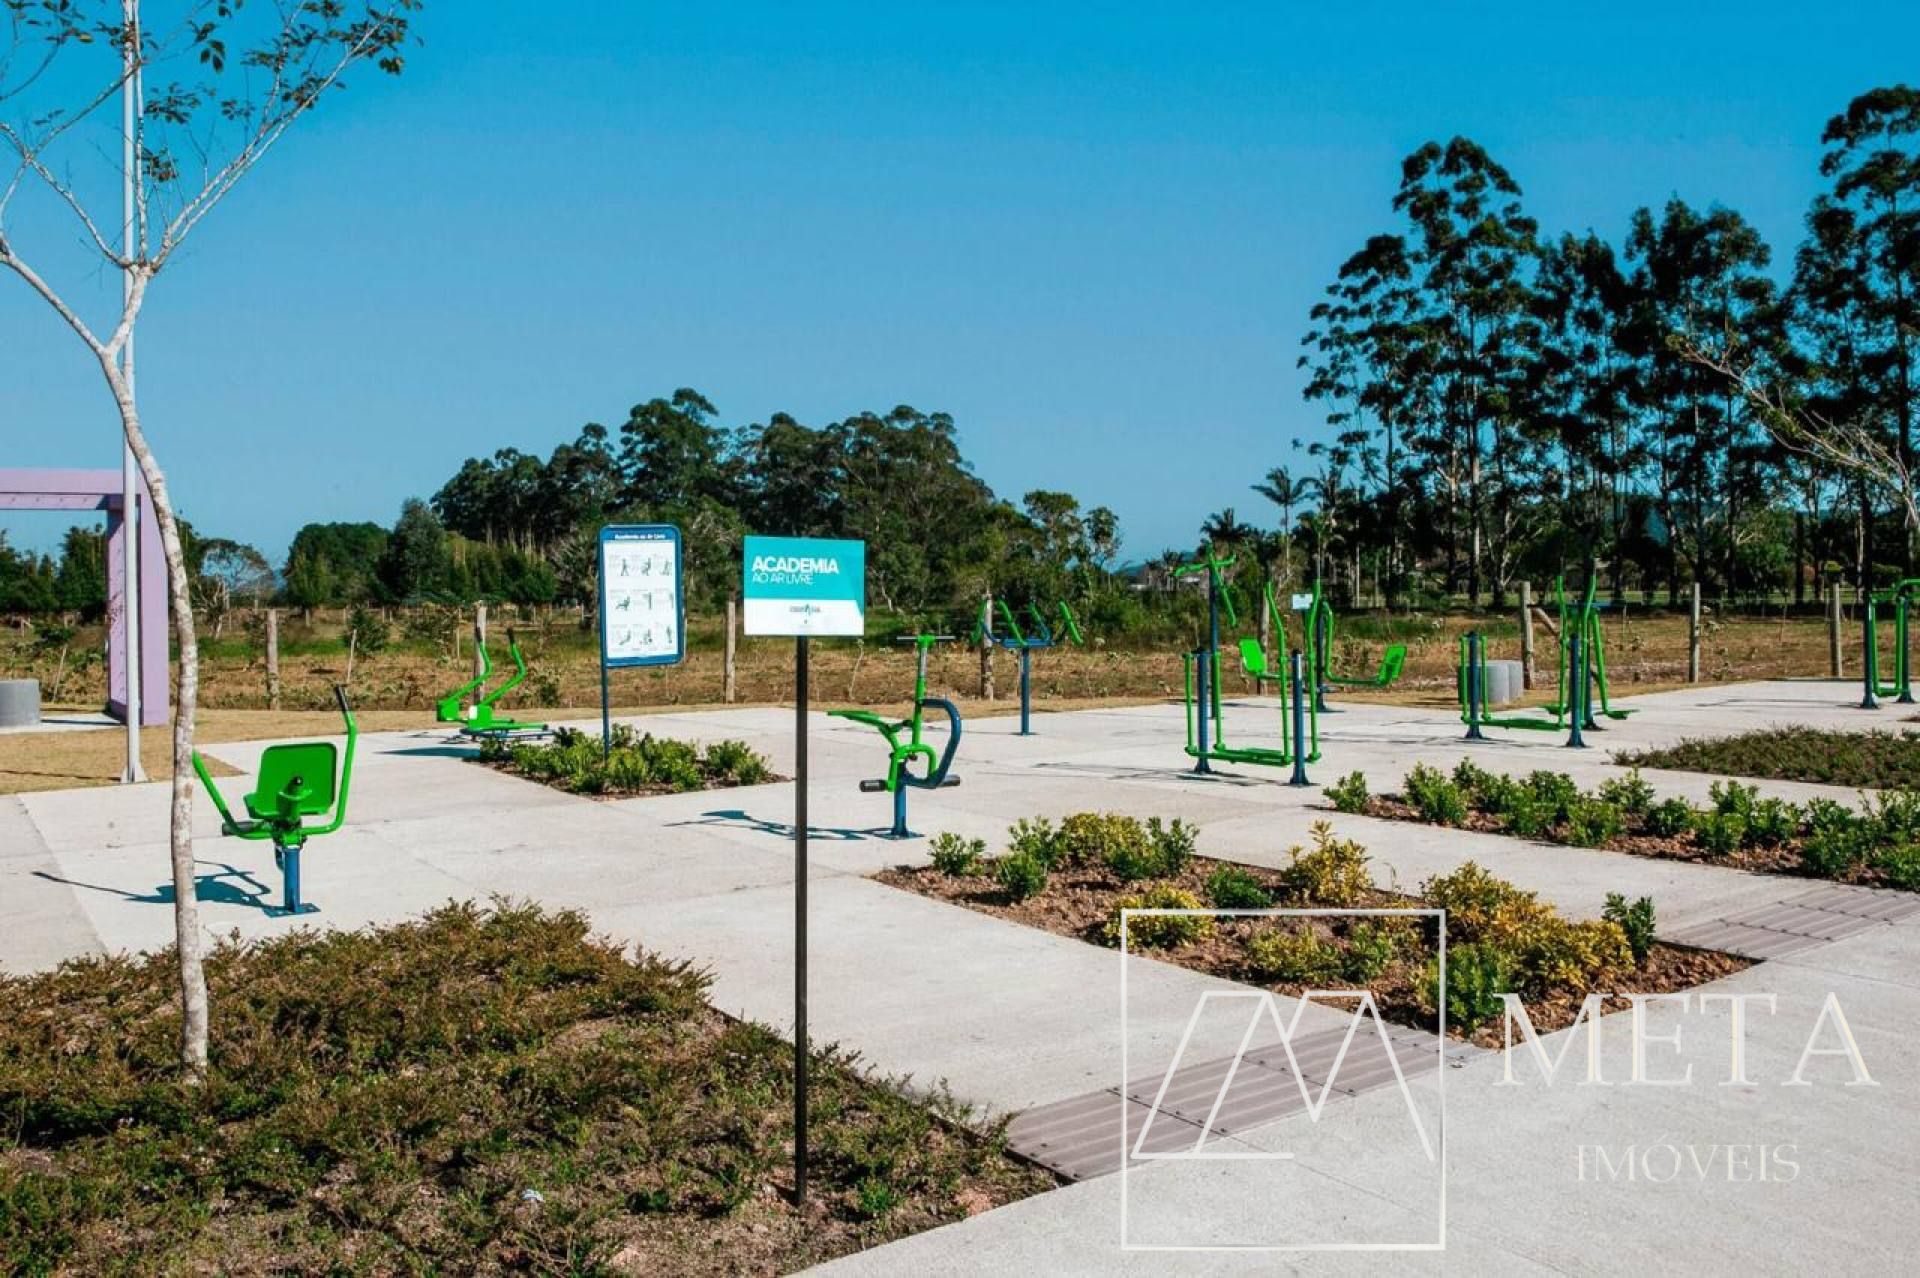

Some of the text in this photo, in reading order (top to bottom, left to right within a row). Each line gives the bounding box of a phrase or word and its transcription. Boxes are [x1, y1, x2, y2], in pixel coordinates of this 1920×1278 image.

[752, 556, 839, 574] ACADEMIA
[752, 573, 813, 585] AO AR LIVRE
